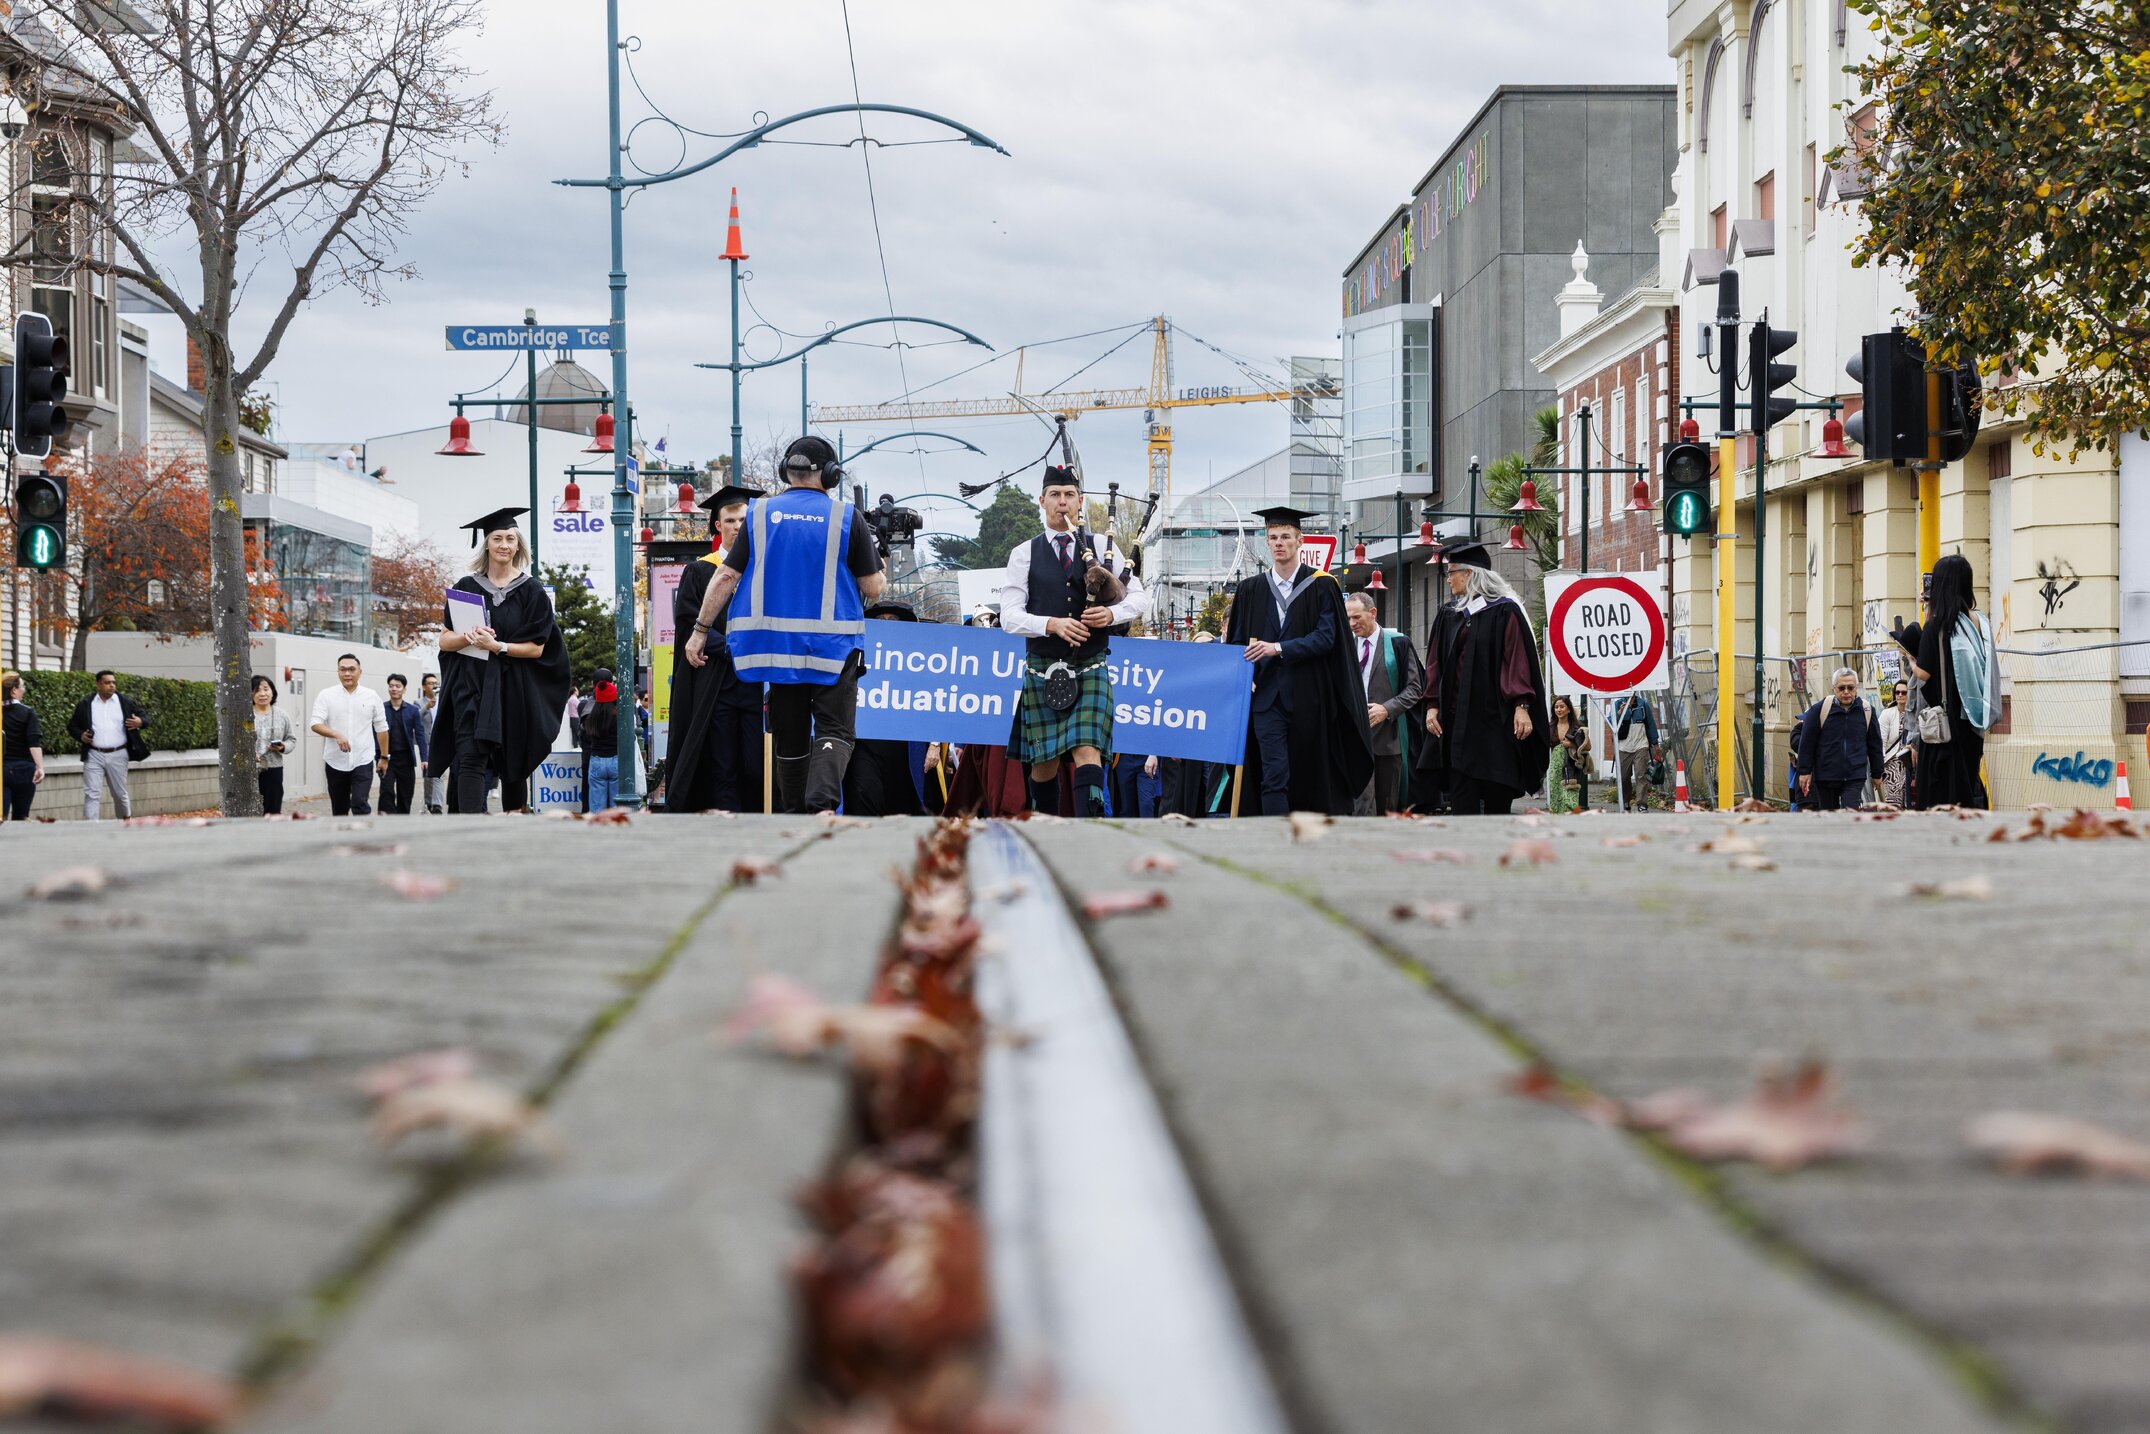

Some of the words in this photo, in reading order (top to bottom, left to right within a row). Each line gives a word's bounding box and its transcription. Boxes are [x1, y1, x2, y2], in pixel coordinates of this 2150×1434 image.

[1417, 201, 1430, 252] TO
[1431, 184, 1442, 240] BE
[1446, 130, 1490, 226] ALRIGHT
[462, 328, 568, 349] Cambridge
[577, 328, 610, 345] Tce
[1180, 386, 1229, 400] LEIGHS
[553, 511, 605, 533] sale
[783, 513, 825, 523] SHIPLEYS
[1299, 550, 1321, 567] GIVE
[1719, 580, 1724, 588] 3
[1582, 603, 1631, 628] ROAD
[1574, 632, 1644, 660] CLOSED
[856, 680, 1002, 716] aduation
[539, 785, 582, 803] Boul
